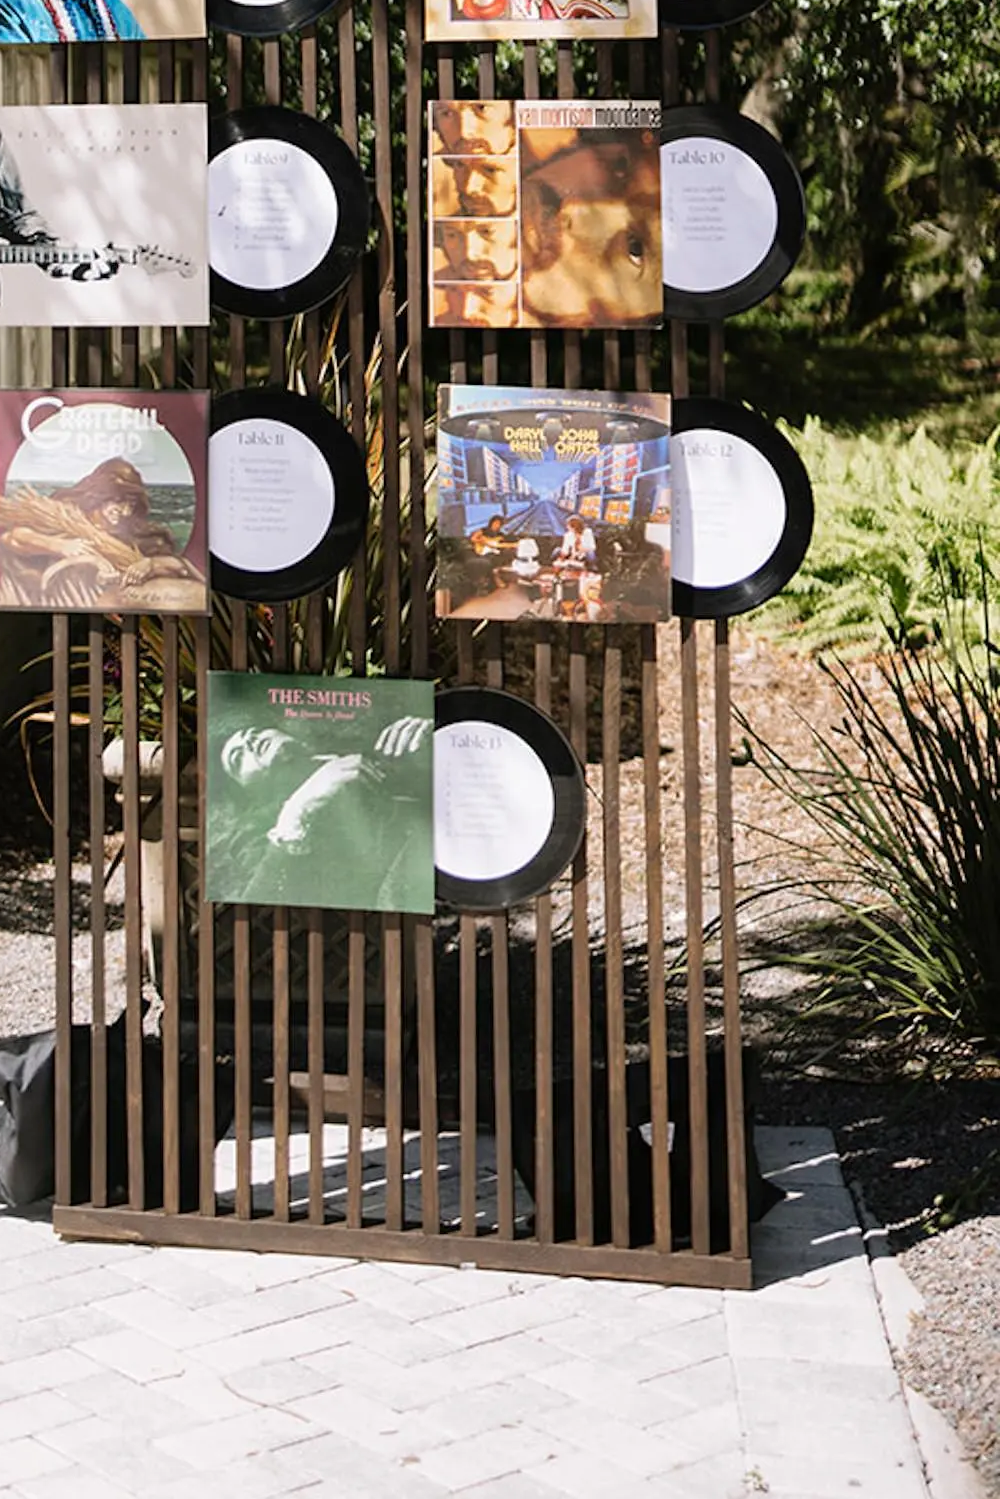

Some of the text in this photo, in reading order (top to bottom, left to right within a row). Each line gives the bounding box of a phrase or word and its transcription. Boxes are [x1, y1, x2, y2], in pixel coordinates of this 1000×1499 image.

[594, 102, 662, 127] moondance
[668, 149, 726, 164] Table 10
[21, 396, 158, 450] GRATEFUL
[238, 431, 272, 446] Table
[504, 427, 545, 442] DARYL
[559, 428, 598, 443] JOHN
[75, 433, 143, 454] DEAD
[268, 689, 372, 708] THE SMITHS
[449, 735, 487, 749] Table
